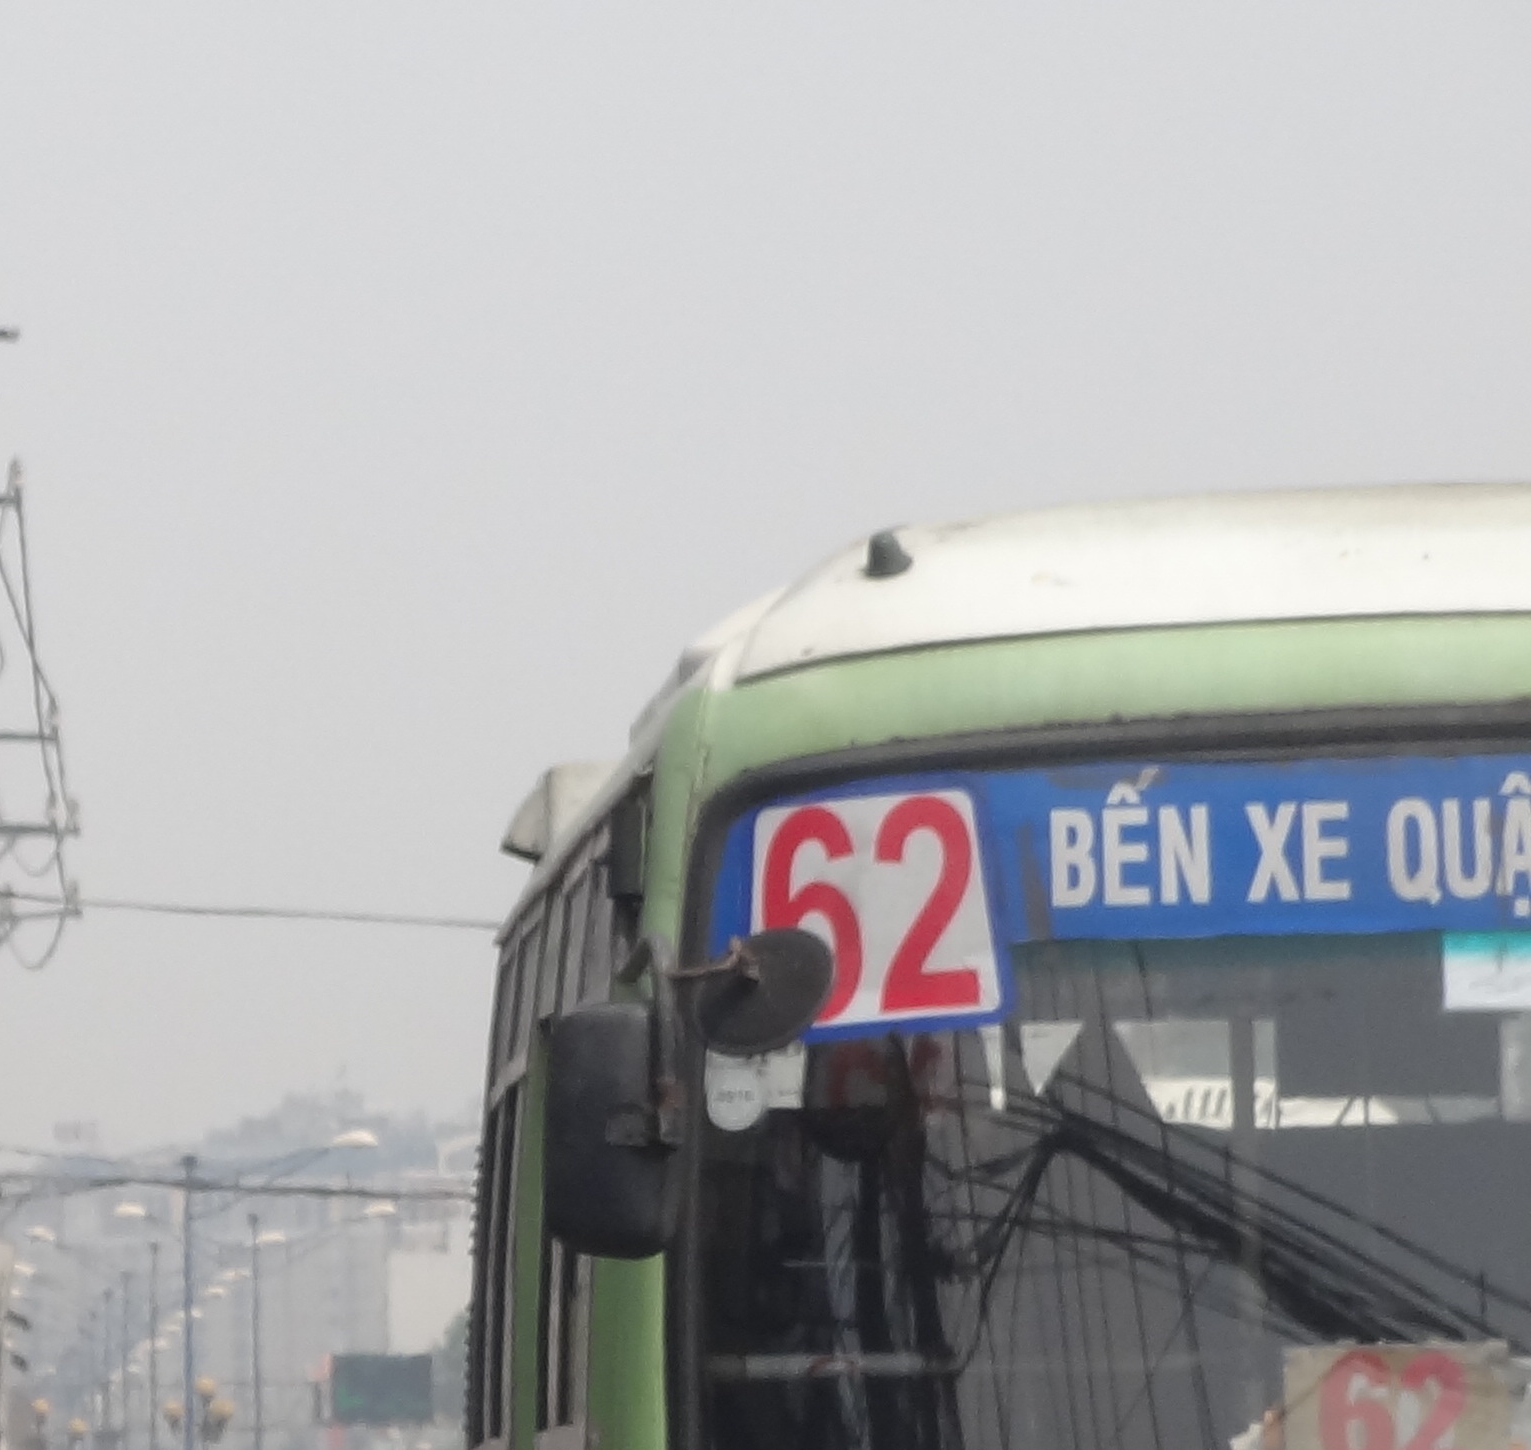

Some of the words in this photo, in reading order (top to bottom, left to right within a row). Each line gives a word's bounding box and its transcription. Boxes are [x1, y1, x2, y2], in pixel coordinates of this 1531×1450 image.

[763, 791, 982, 1026] 62
[1049, 765, 1213, 909] BẾN
[1245, 800, 1352, 902] XE
